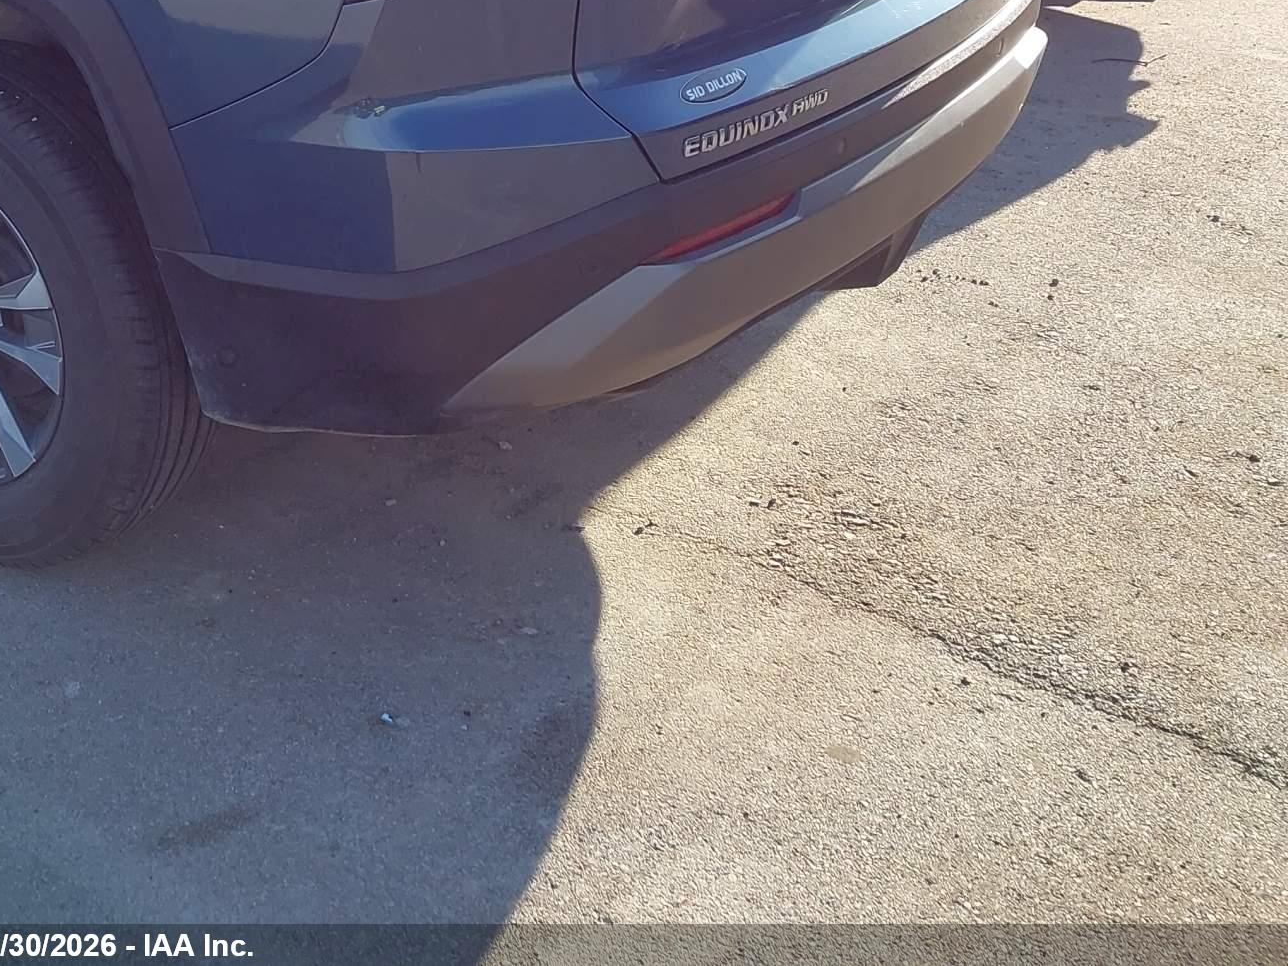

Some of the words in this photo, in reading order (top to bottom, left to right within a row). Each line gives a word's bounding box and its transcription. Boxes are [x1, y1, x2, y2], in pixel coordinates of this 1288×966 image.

[686, 85, 705, 101] SID
[705, 70, 741, 93] DILLON
[683, 104, 789, 158] EQUINOX
[791, 88, 830, 116] AWD
